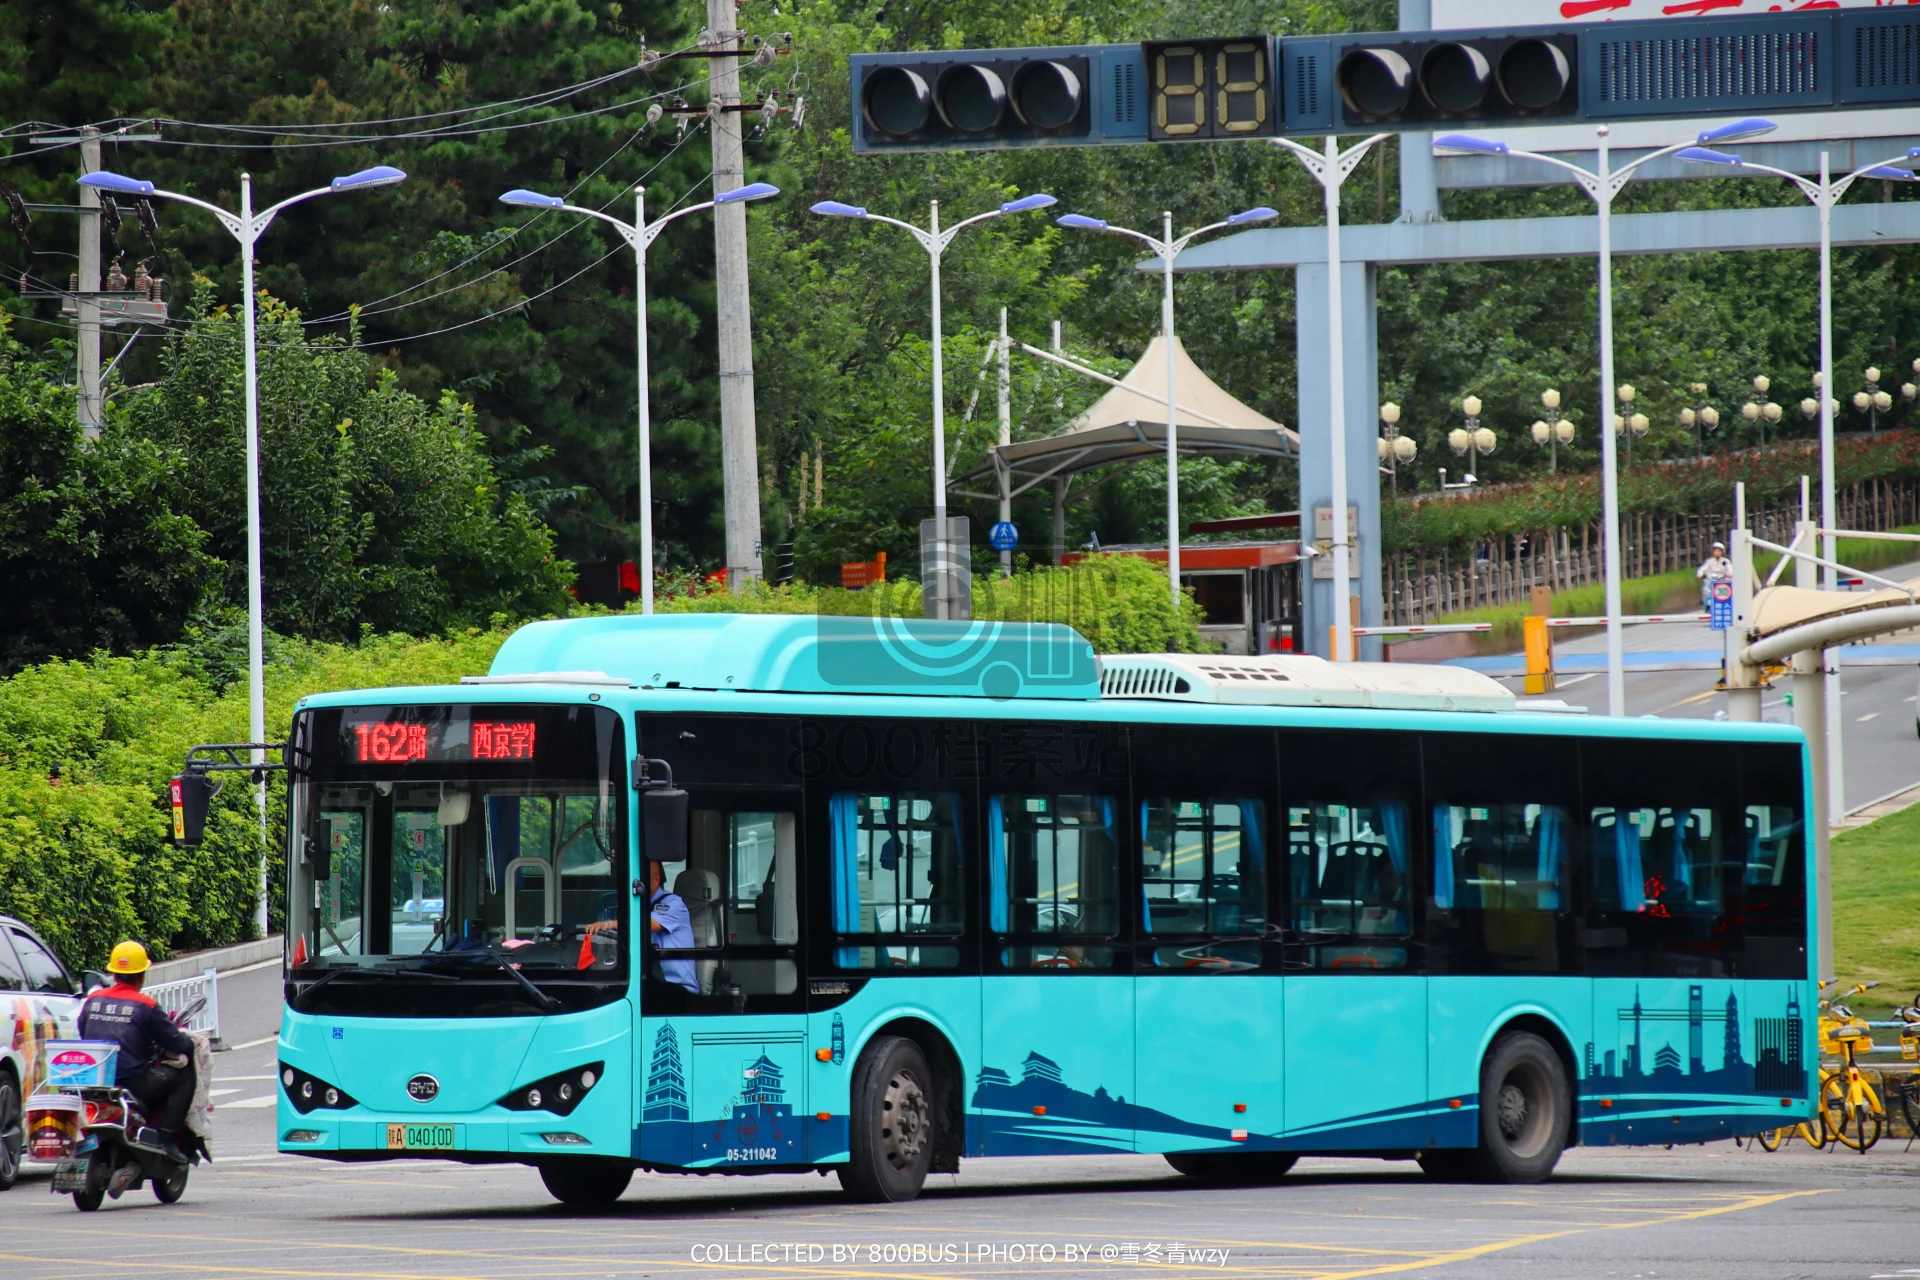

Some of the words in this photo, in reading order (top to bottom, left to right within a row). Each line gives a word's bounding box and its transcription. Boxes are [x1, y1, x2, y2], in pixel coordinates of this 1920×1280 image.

[1716, 587, 1729, 597] 30
[355, 721, 428, 763] 162路
[409, 1082, 435, 1094] BYD
[727, 1147, 777, 1161] 05-211042
